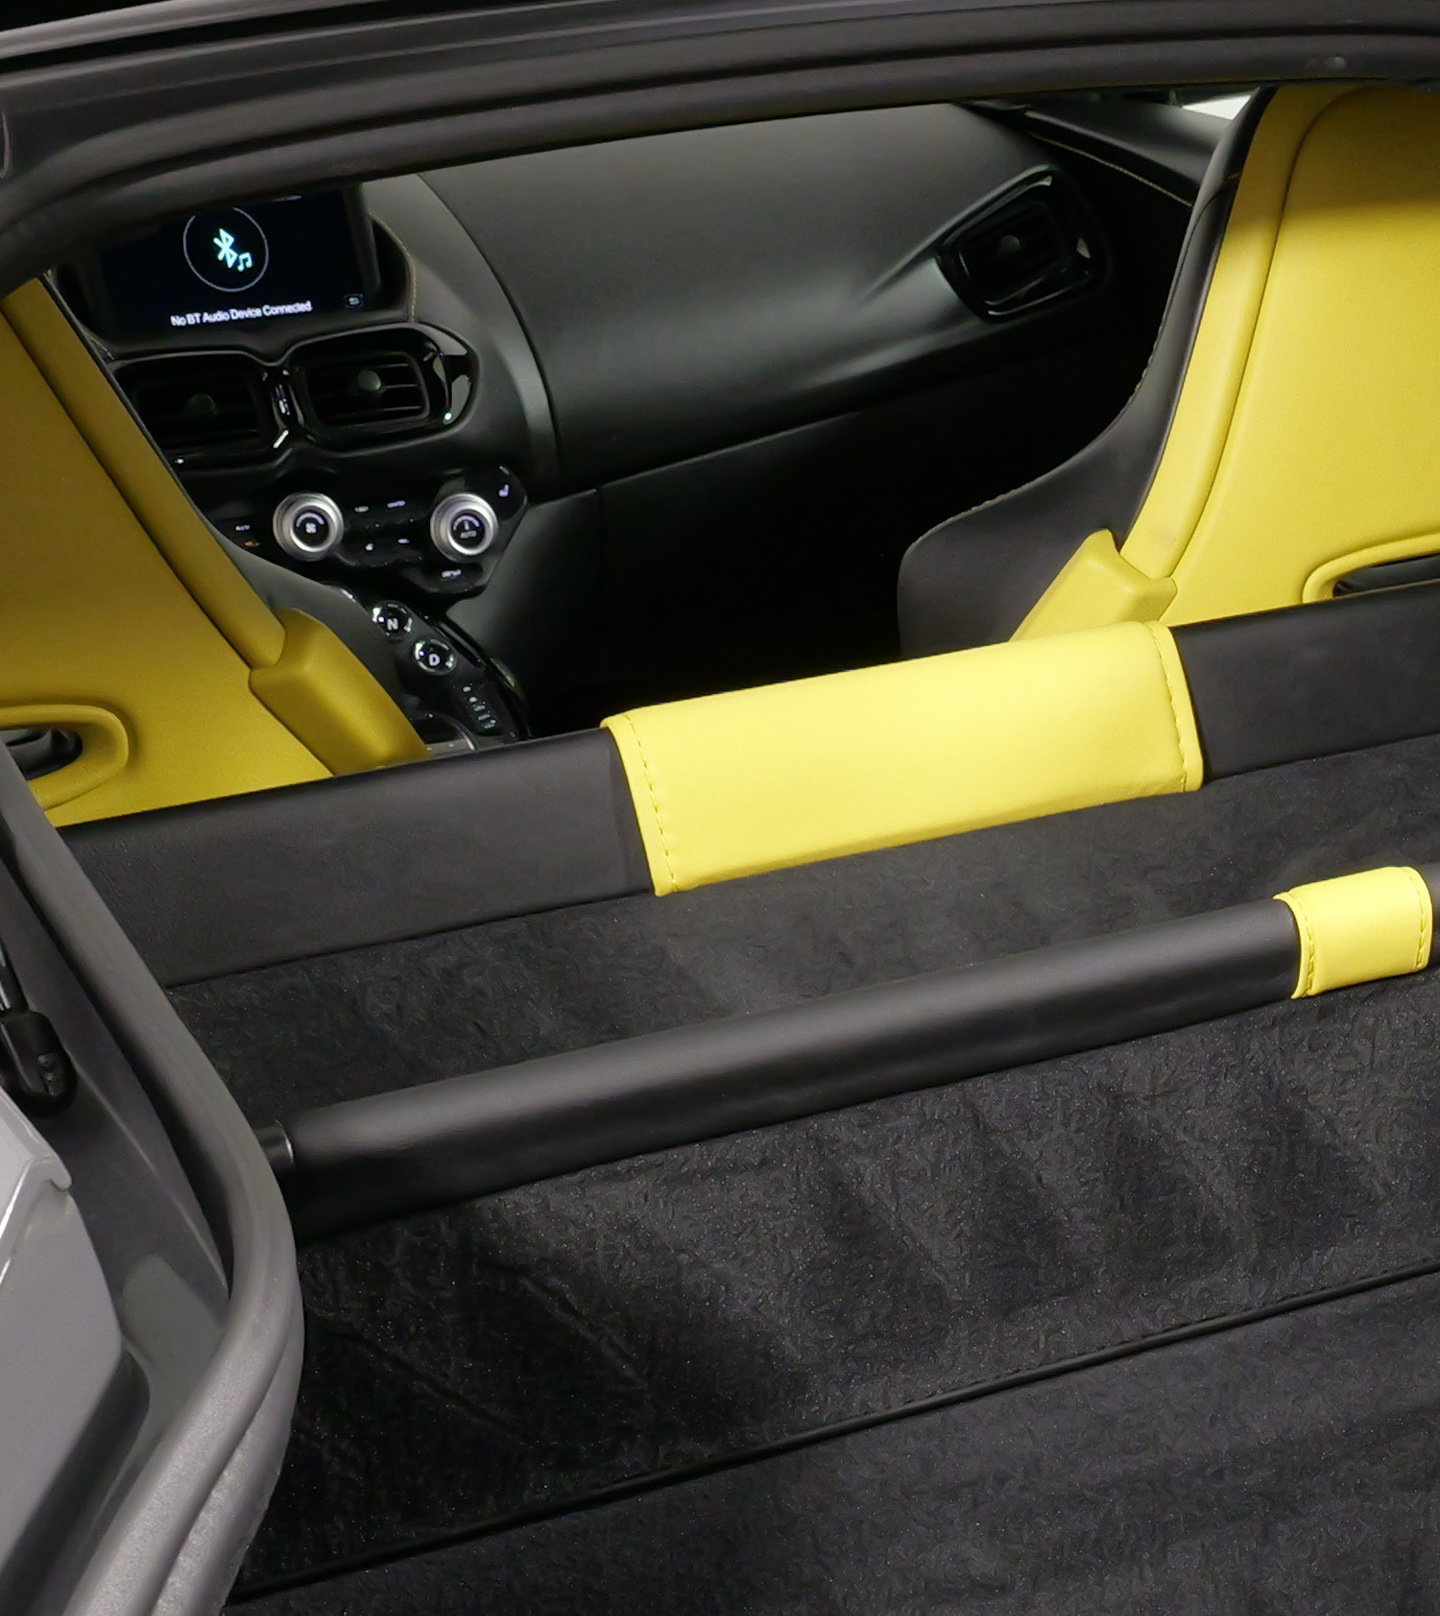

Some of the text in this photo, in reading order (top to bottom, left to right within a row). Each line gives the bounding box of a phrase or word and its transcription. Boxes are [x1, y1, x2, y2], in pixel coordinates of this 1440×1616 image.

[170, 300, 312, 326] No BT Audio Device Connected
[386, 618, 399, 631] N
[428, 653, 441, 667] D
